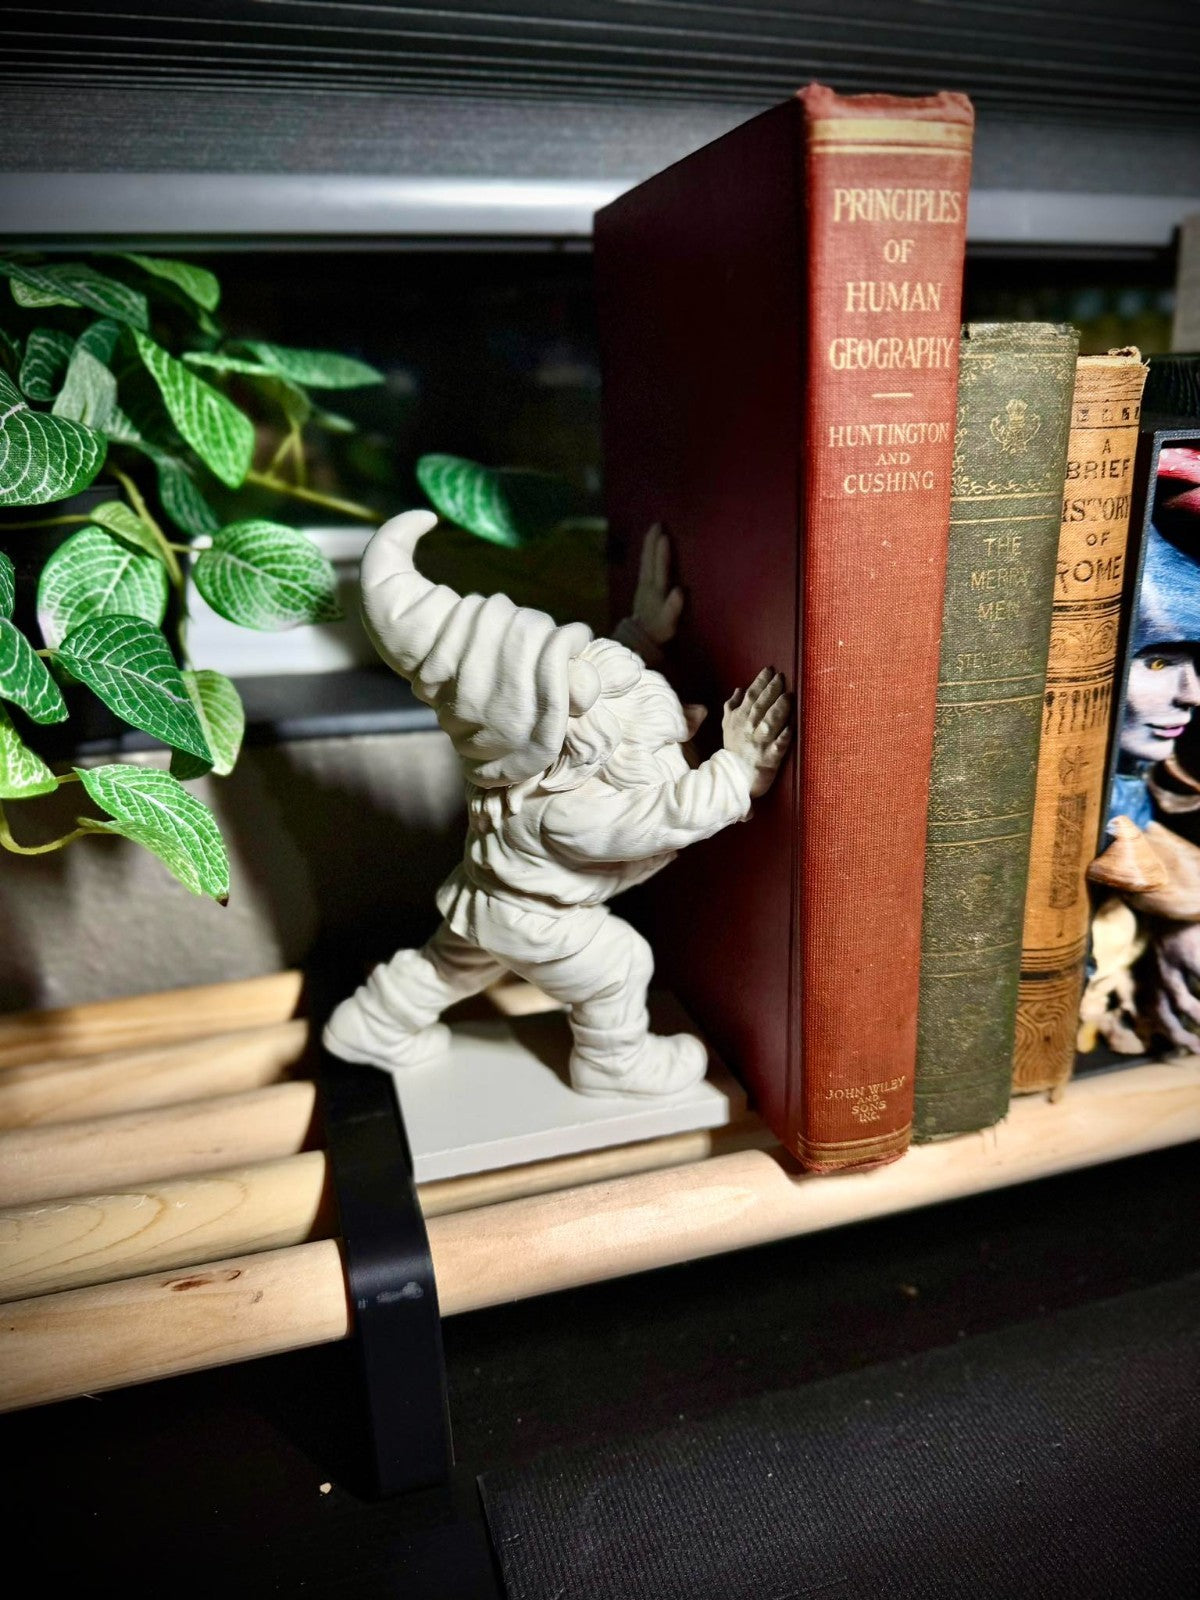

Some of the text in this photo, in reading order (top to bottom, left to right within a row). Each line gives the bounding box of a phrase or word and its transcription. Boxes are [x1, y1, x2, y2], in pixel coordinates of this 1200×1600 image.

[833, 188, 962, 223] PRINCIPLES
[883, 239, 915, 263] OF
[844, 281, 942, 312] HUMAN
[828, 337, 955, 370] GEOGRAPHY
[827, 422, 950, 447] HUNTINGTON
[1102, 438, 1111, 454] A
[875, 452, 911, 466] AND
[1065, 458, 1131, 479] BRIEF
[843, 471, 934, 494] CUSHING
[983, 536, 1022, 557] THE
[1085, 531, 1110, 546] OF
[970, 566, 1029, 591] MERRY
[978, 600, 1021, 622] MEN
[825, 1075, 905, 1100] JOHN WILEY
[851, 1100, 887, 1115] SONS
